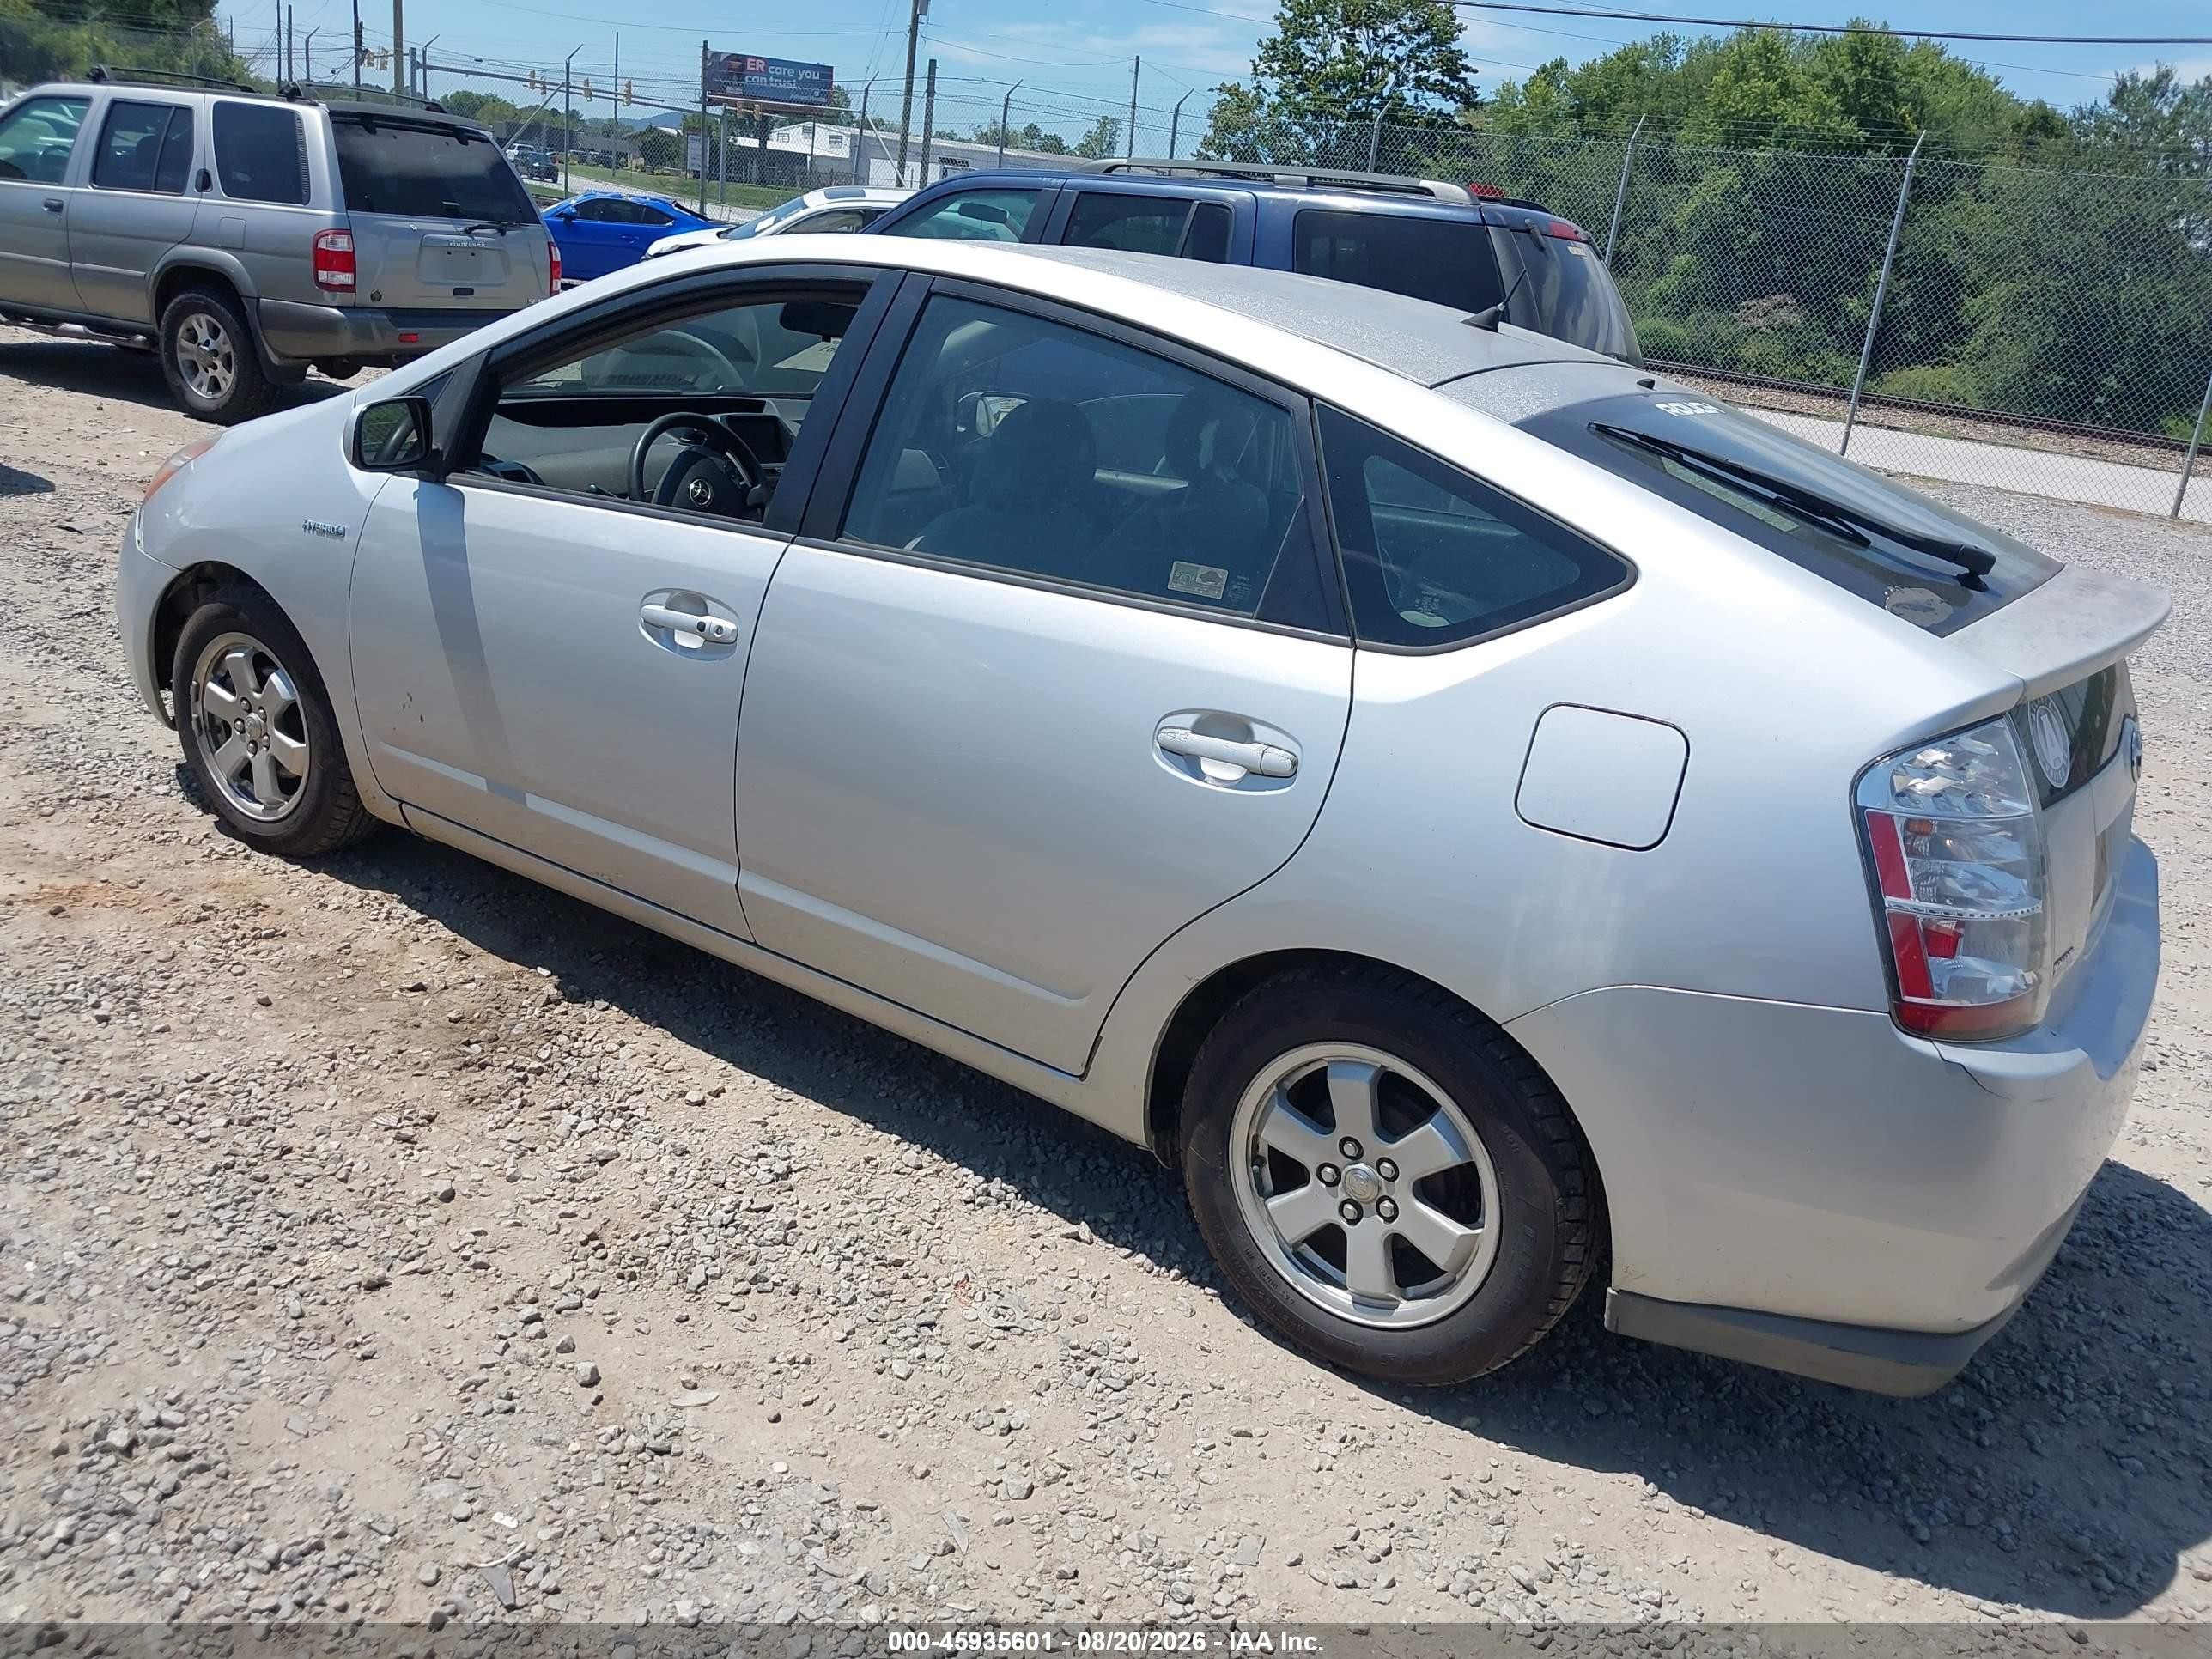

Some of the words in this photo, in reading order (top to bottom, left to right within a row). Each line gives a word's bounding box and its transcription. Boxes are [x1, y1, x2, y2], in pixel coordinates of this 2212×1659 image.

[746, 58, 765, 71] ER
[768, 64, 795, 76] care
[798, 70, 820, 81] you
[744, 75, 767, 85] can
